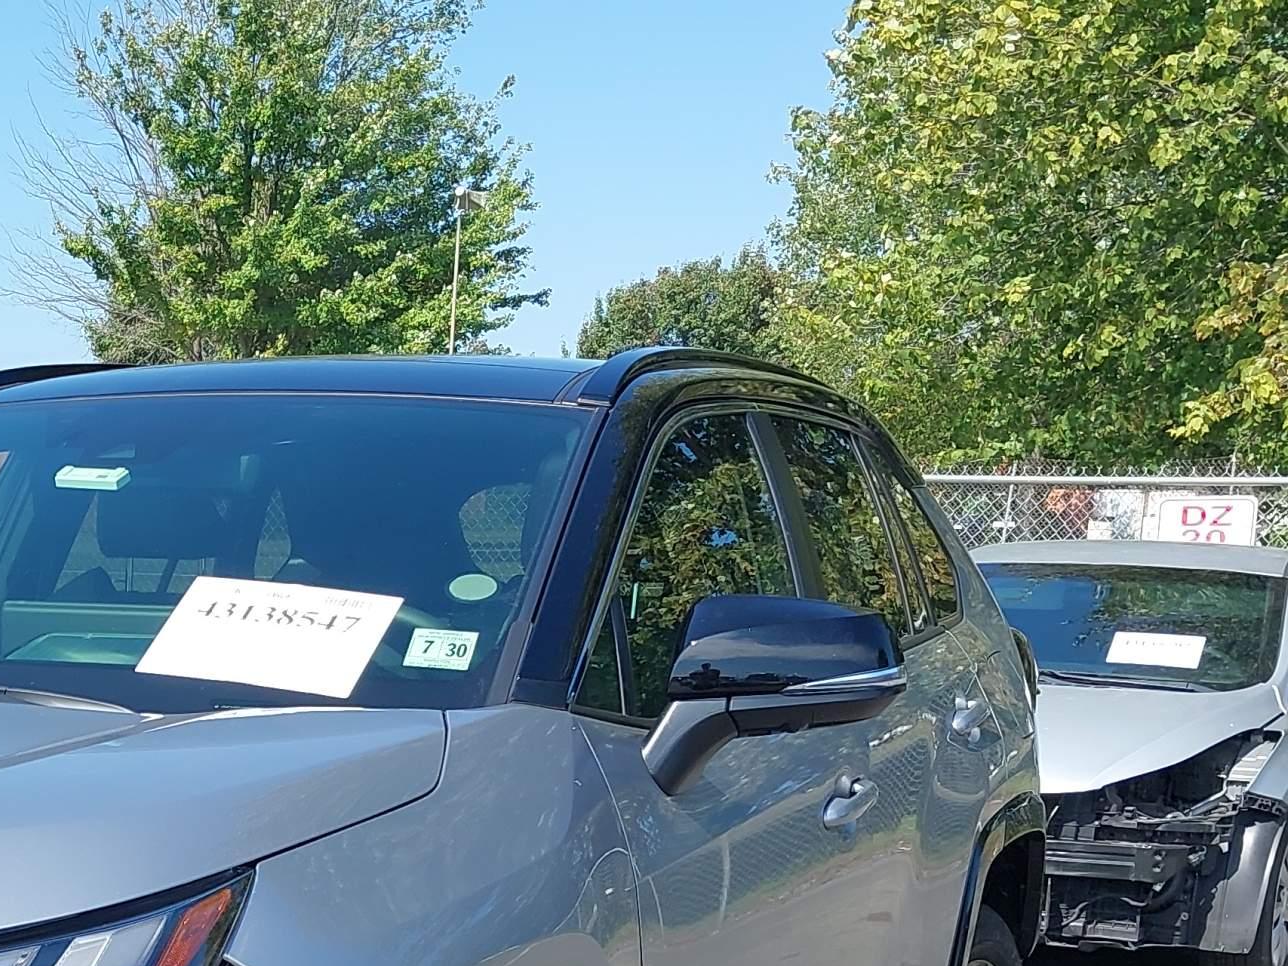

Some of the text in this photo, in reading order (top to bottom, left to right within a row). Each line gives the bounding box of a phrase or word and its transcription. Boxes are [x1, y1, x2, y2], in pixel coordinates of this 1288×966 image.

[1181, 505, 1233, 526] DZ
[197, 601, 361, 633] 43138547
[421, 639, 468, 658] 7 30
